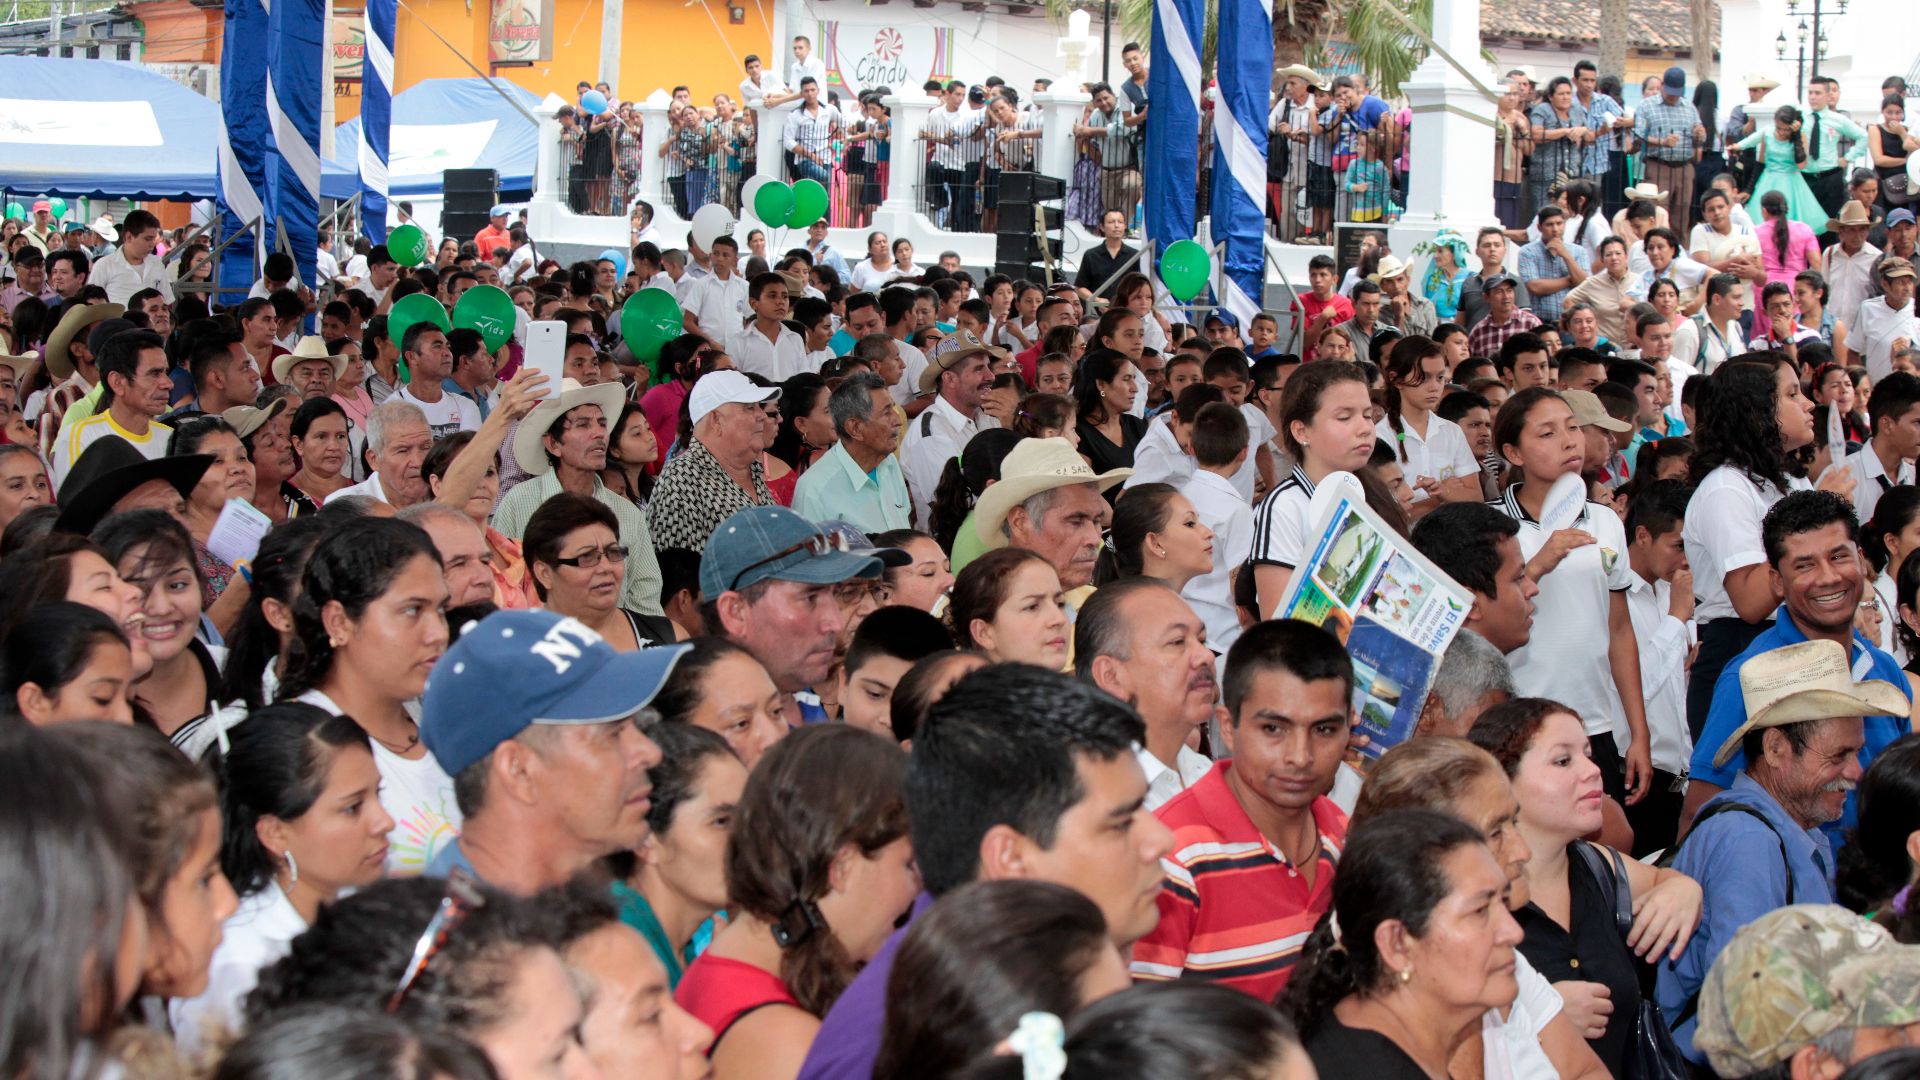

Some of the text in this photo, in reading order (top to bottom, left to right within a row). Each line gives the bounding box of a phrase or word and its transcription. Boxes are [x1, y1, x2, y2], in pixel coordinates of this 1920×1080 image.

[856, 55, 907, 87] Candy
[1444, 611, 1458, 624] El
[530, 616, 603, 674] NY
